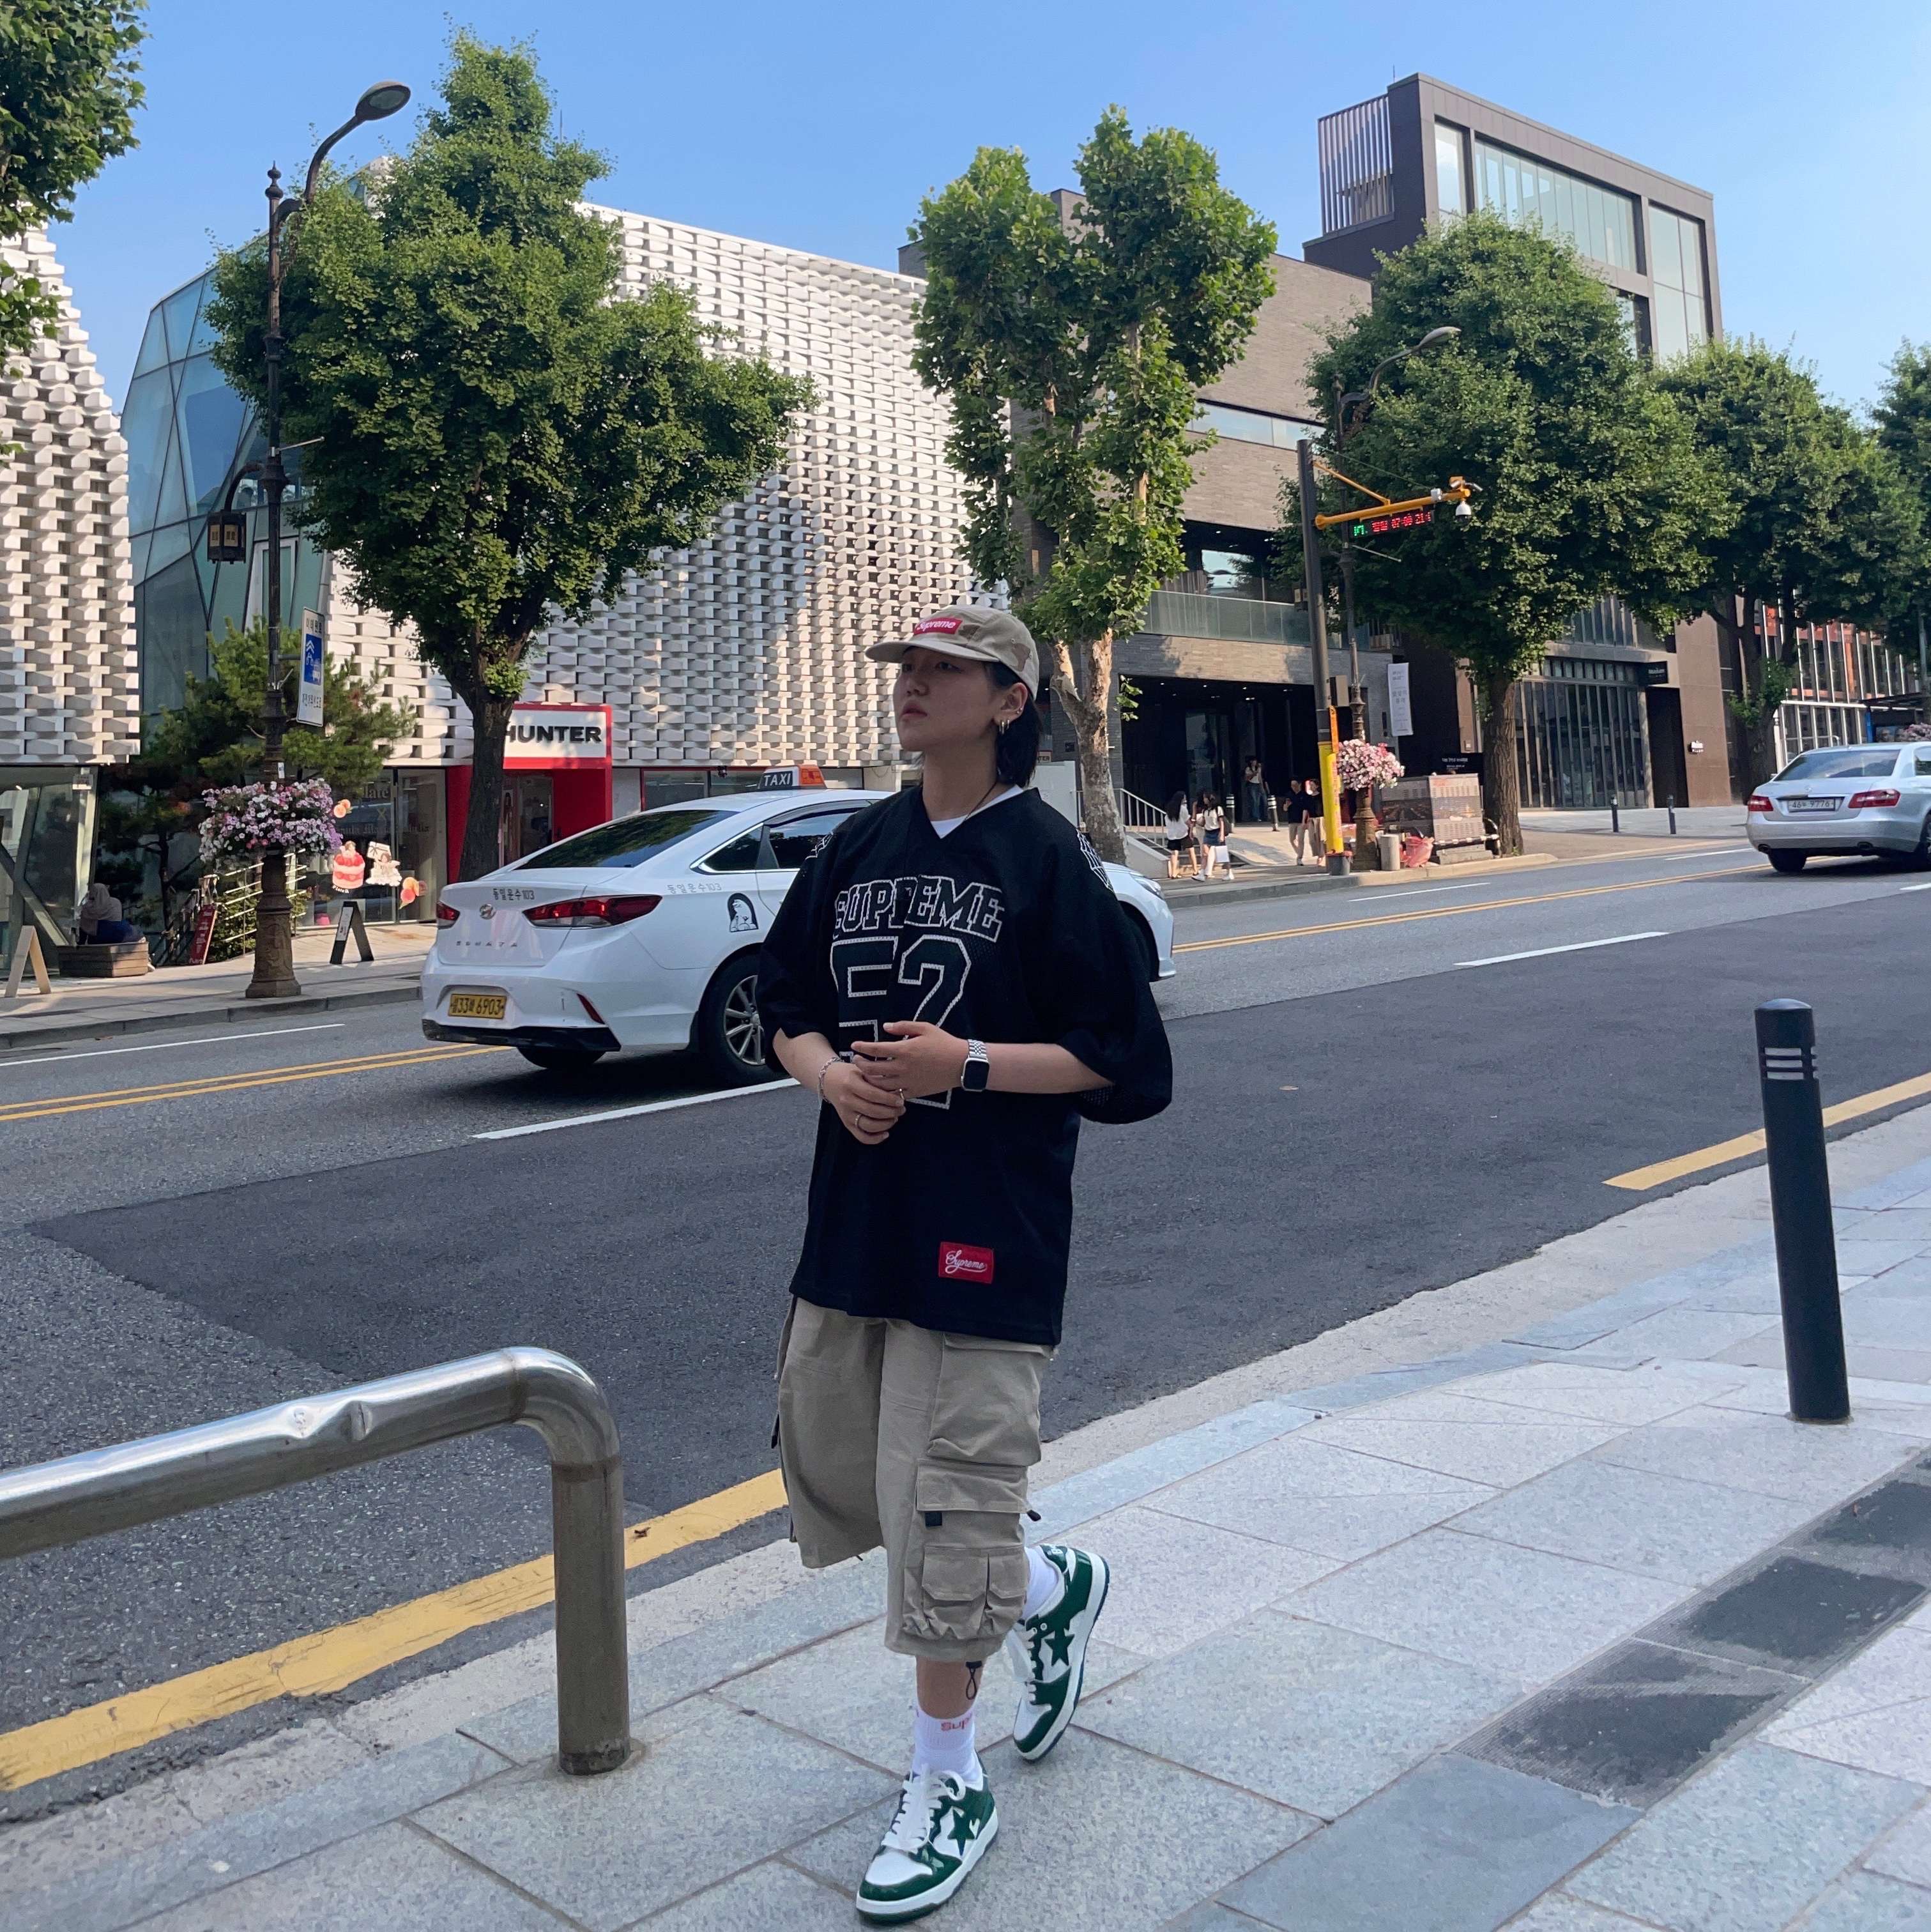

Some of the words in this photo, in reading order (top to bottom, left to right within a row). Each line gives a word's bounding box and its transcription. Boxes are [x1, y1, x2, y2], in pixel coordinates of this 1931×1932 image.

[917, 620, 956, 631] Supreme
[506, 725, 602, 742] HUNTER
[764, 774, 791, 786] TAXI
[493, 888, 535, 901] 동일운수103
[476, 997, 502, 1015] 6903
[945, 1250, 988, 1274] Supreme
